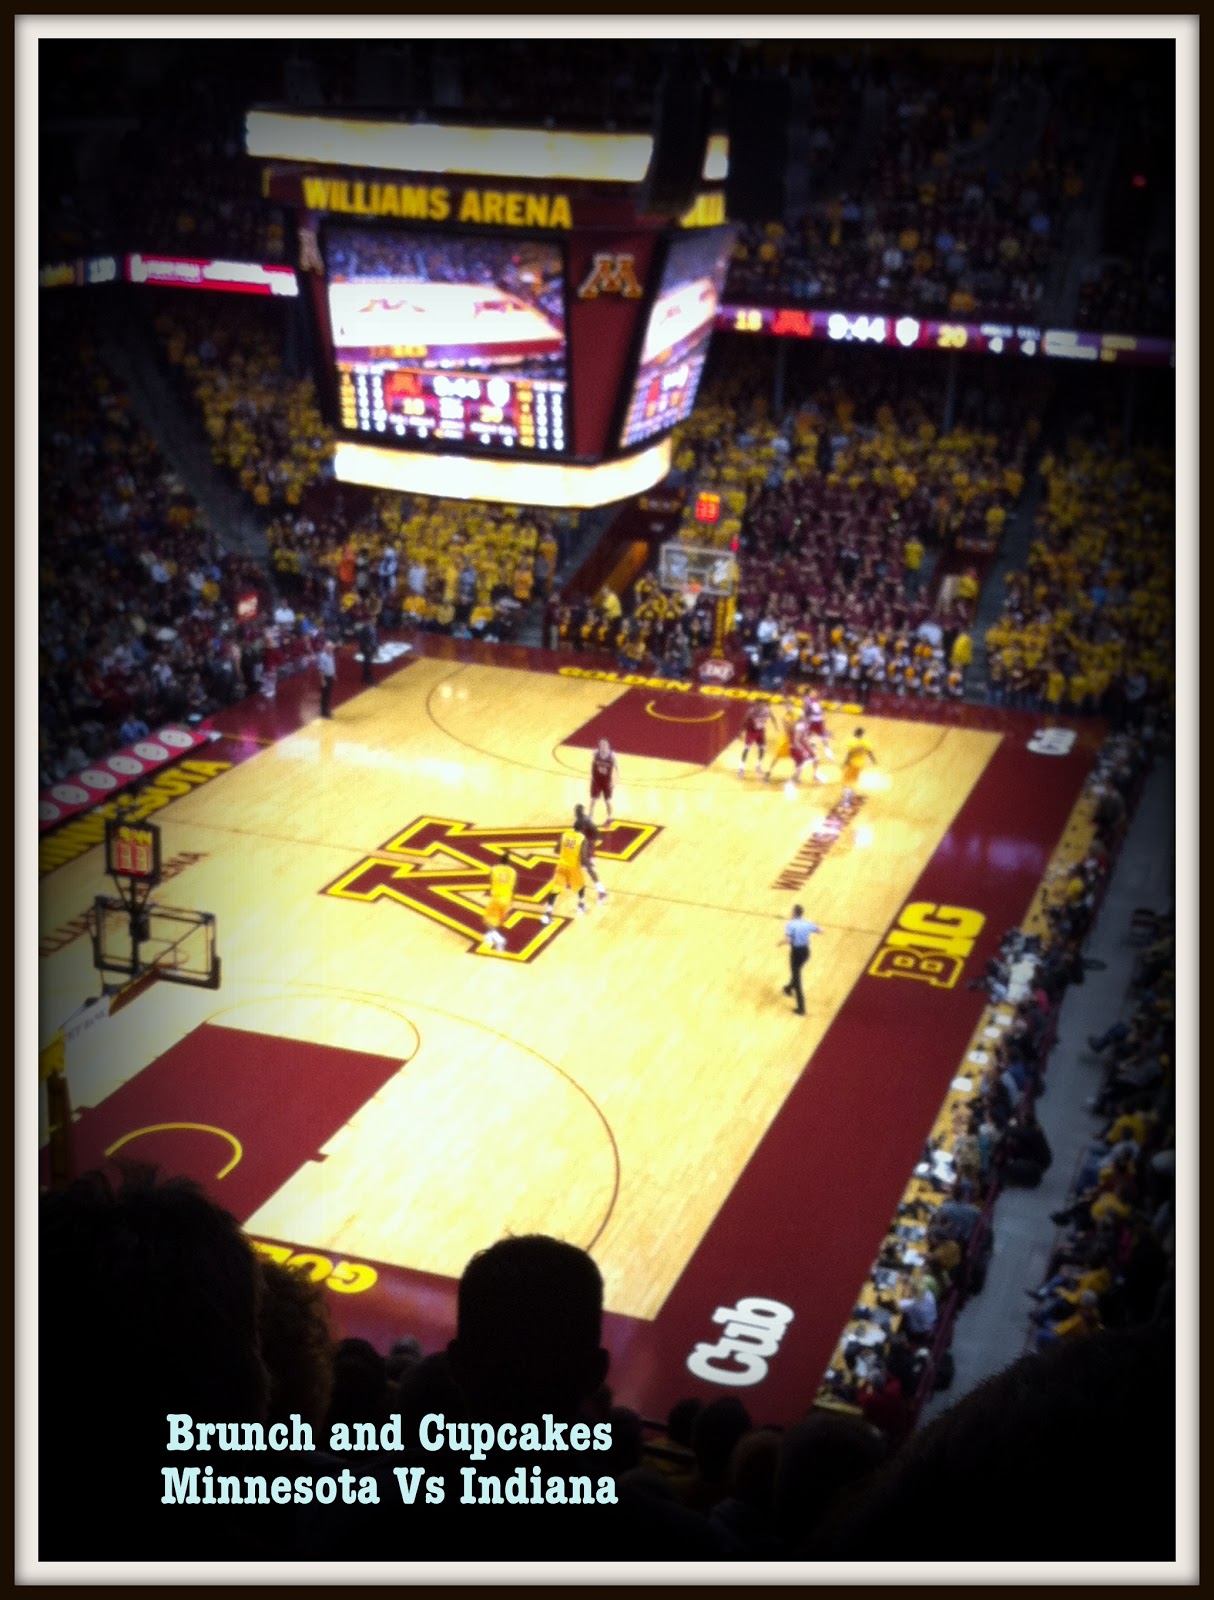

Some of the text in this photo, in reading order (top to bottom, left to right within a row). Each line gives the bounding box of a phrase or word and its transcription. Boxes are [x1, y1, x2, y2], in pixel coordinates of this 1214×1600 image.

[303, 177, 573, 230] WILLIAMS ARENA
[686, 1296, 795, 1386] Cub
